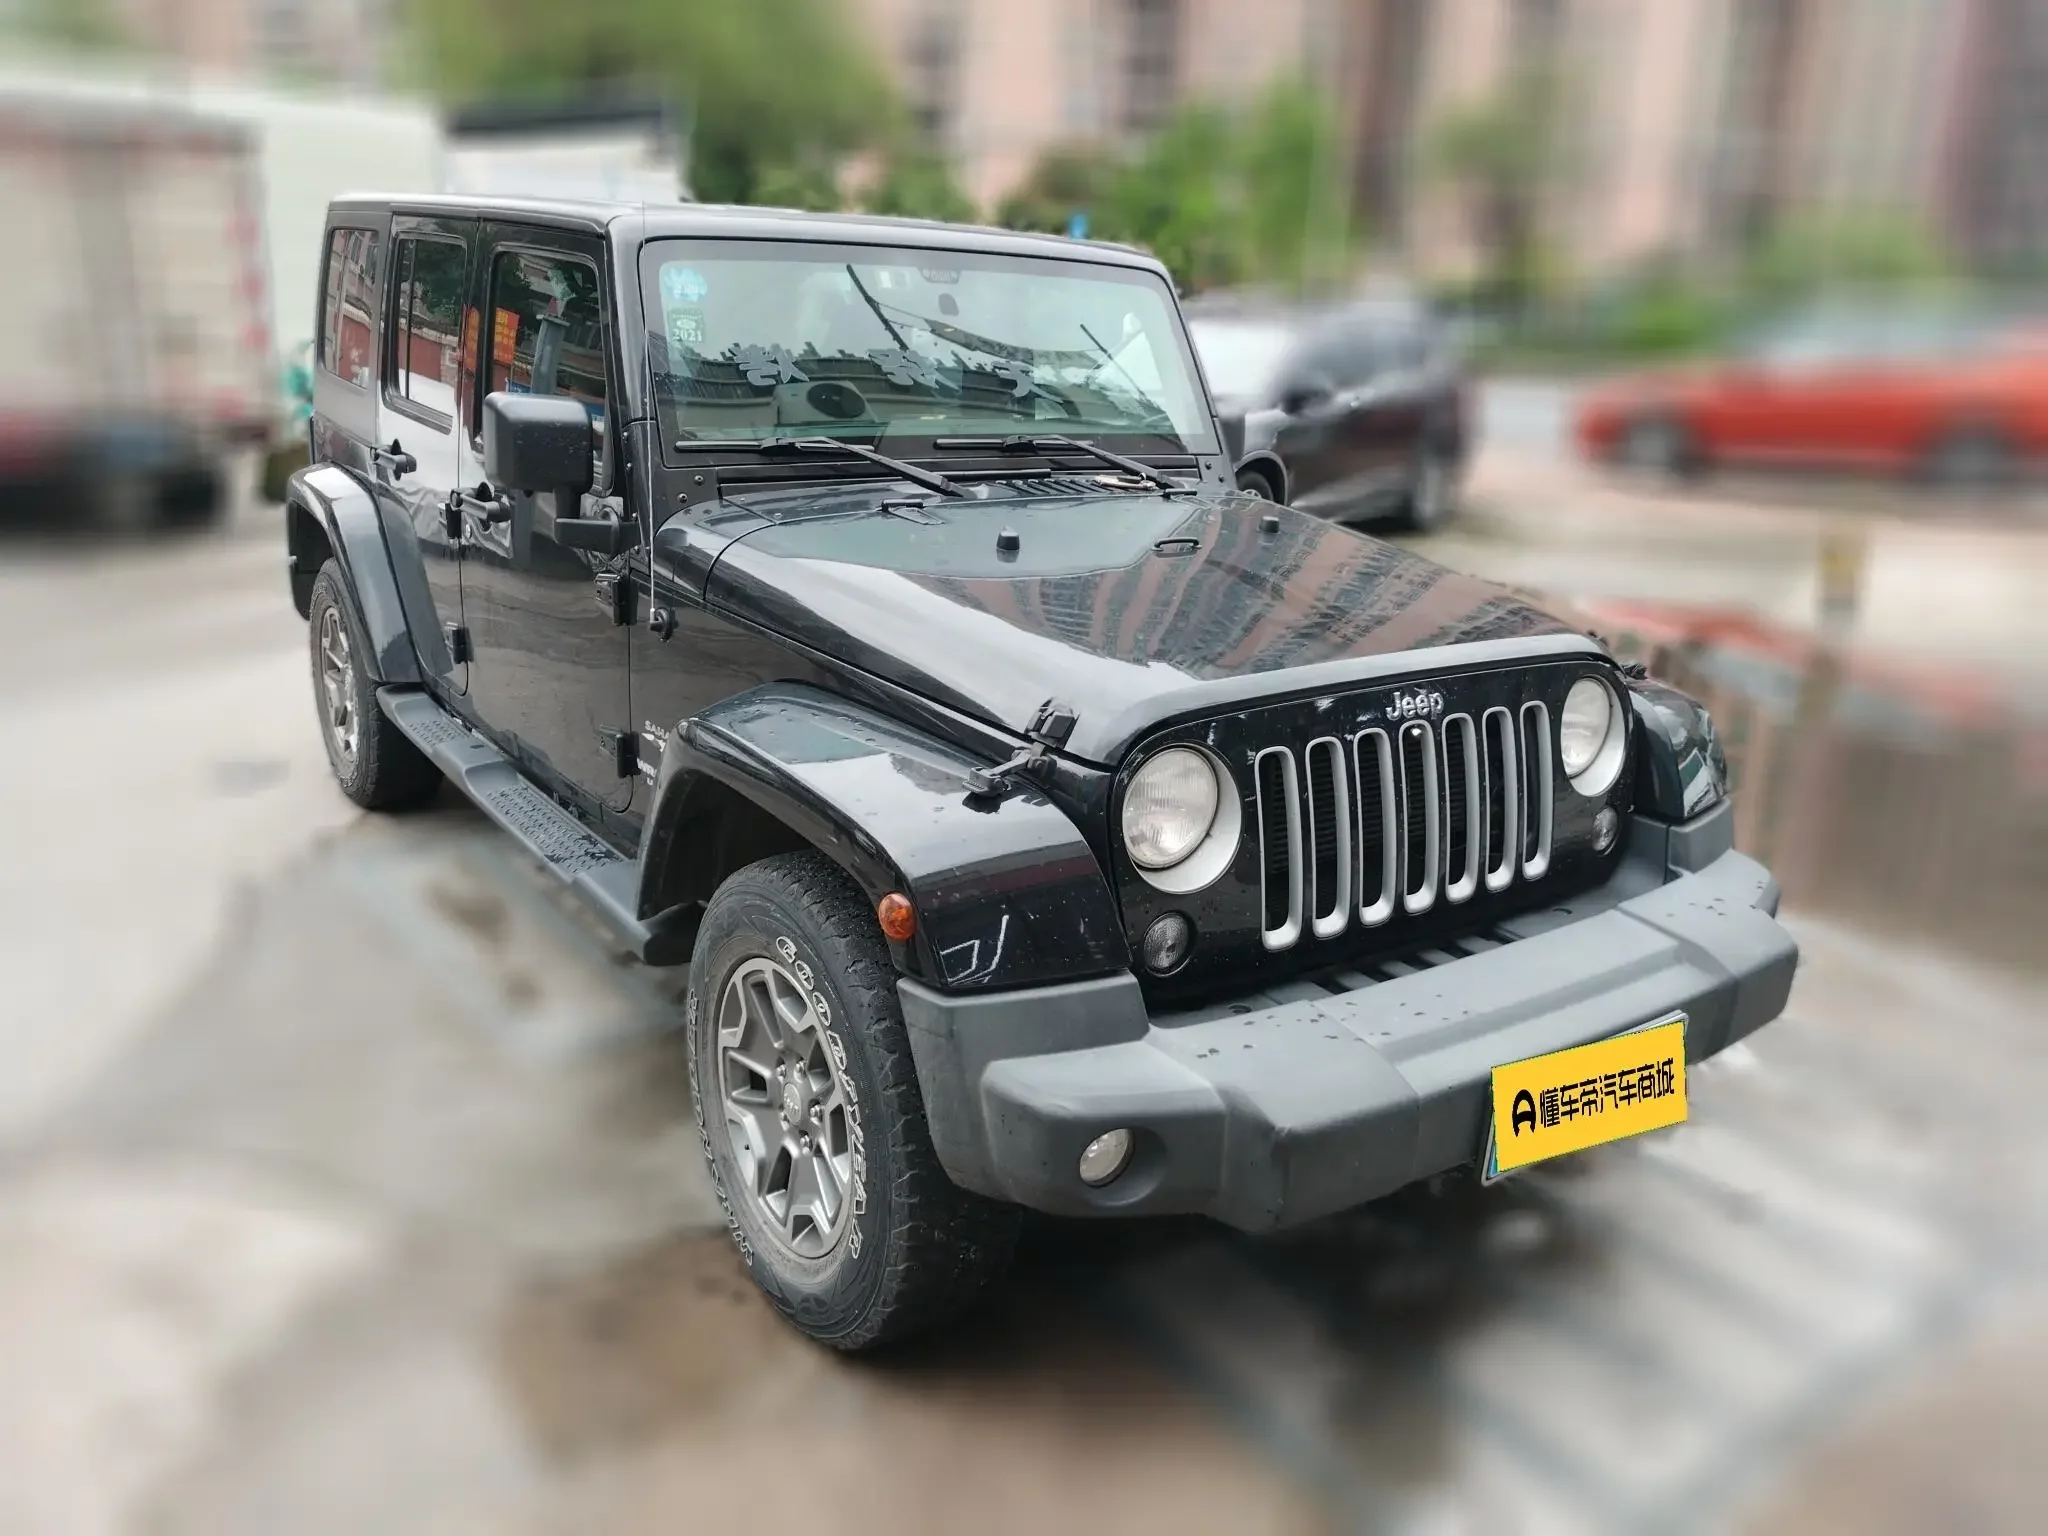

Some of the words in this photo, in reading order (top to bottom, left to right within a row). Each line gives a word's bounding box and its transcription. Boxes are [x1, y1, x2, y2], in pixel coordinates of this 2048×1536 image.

[672, 328, 703, 342] 2021
[1385, 691, 1444, 721] Jeep
[776, 936, 867, 1259] GOODYEAR
